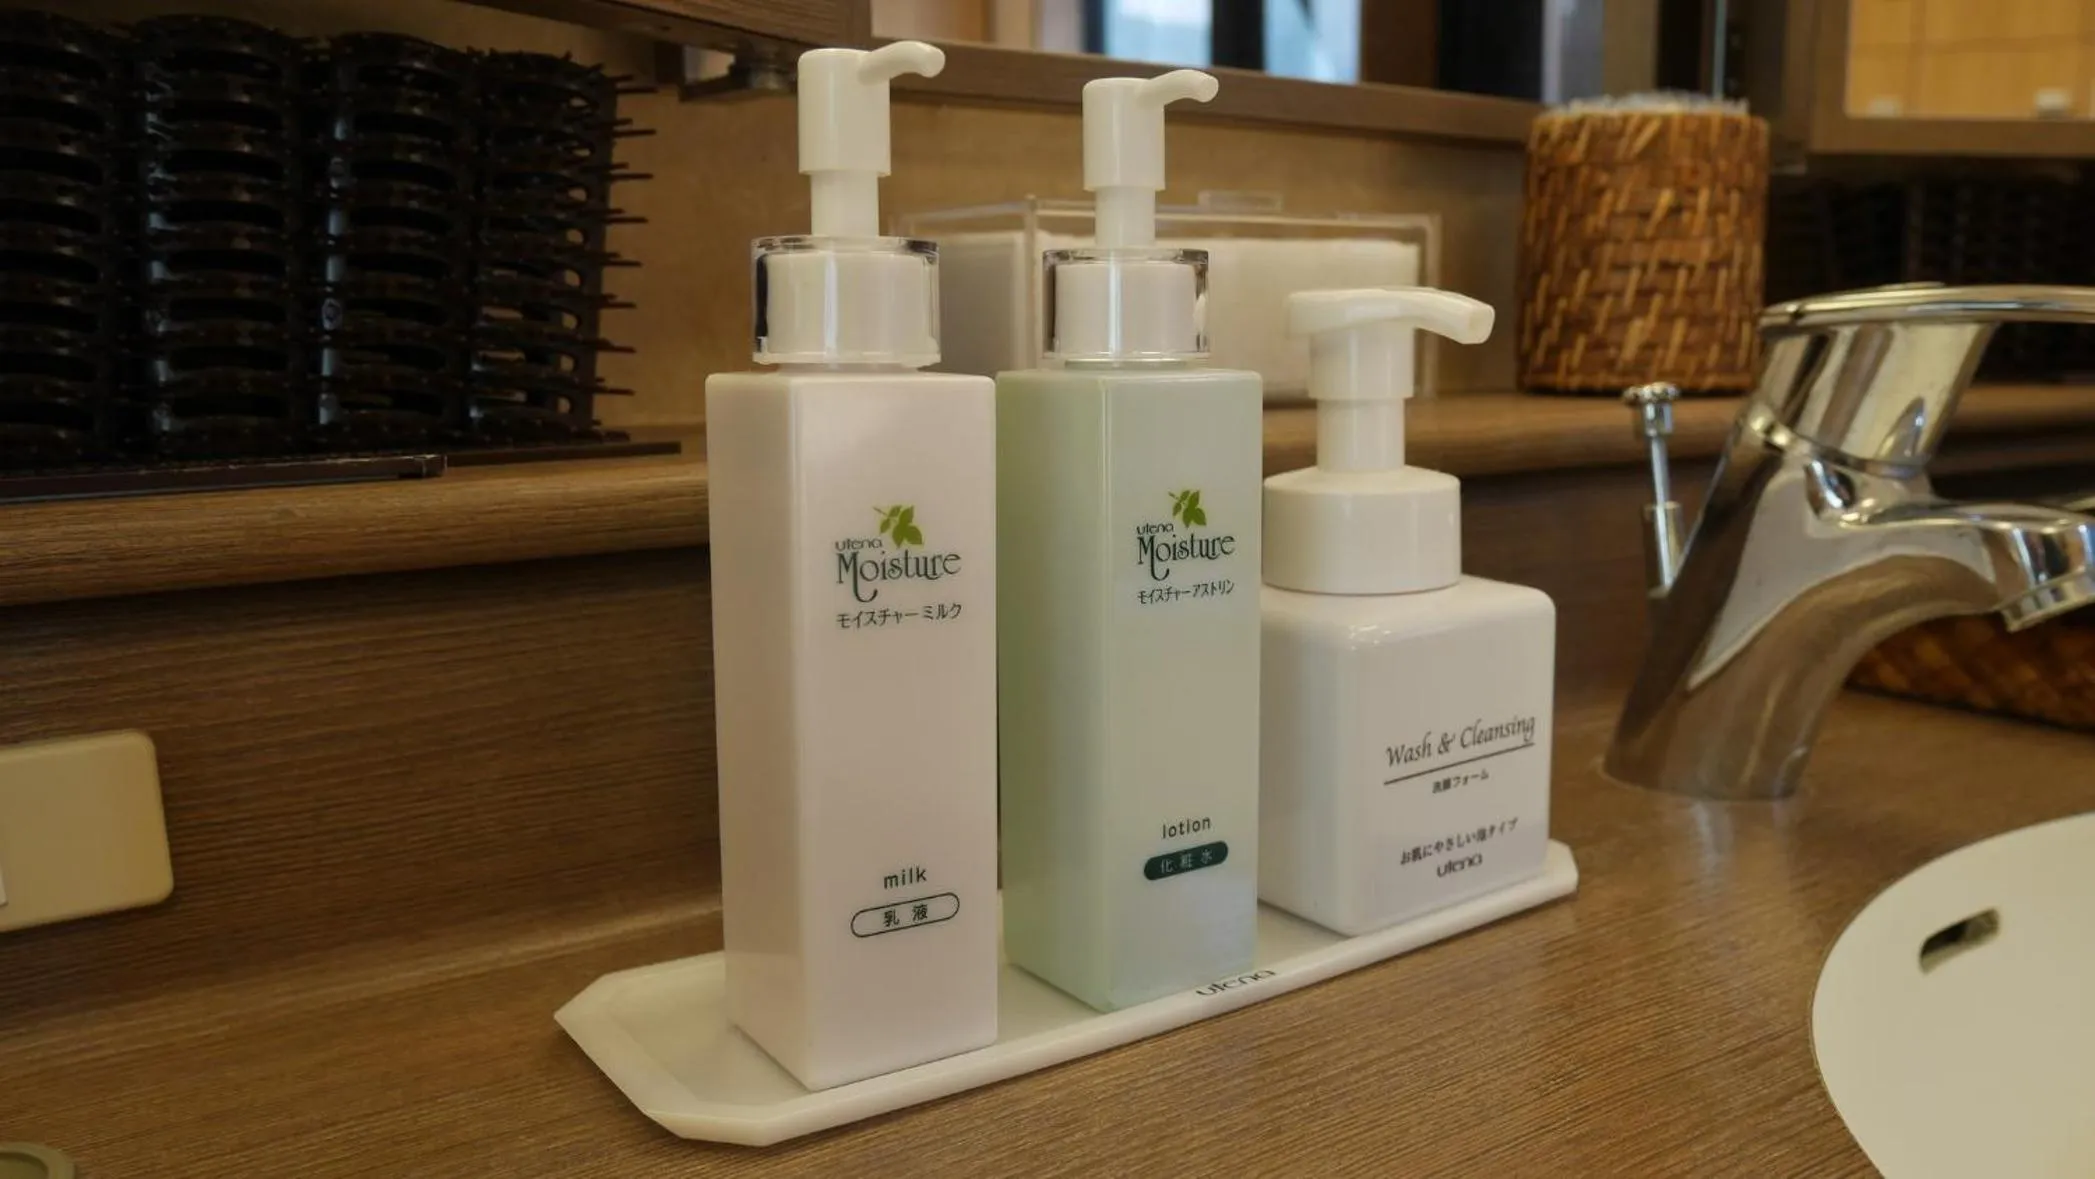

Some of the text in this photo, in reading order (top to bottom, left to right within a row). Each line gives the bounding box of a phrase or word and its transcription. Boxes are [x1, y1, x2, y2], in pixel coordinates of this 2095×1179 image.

[1136, 522, 1174, 535] utena
[835, 538, 882, 551] utena
[1137, 533, 1235, 581] Moisture
[836, 549, 961, 603] Moisture
[1137, 579, 1235, 605] モイスチャーアストリン
[837, 602, 962, 629] モイスチャーミルク
[1385, 716, 1536, 767] Wash & Cleansing
[1432, 768, 1489, 794] 洗フォーム
[1162, 816, 1212, 839] lotion
[883, 866, 927, 889] milk
[1437, 853, 1483, 878] utena
